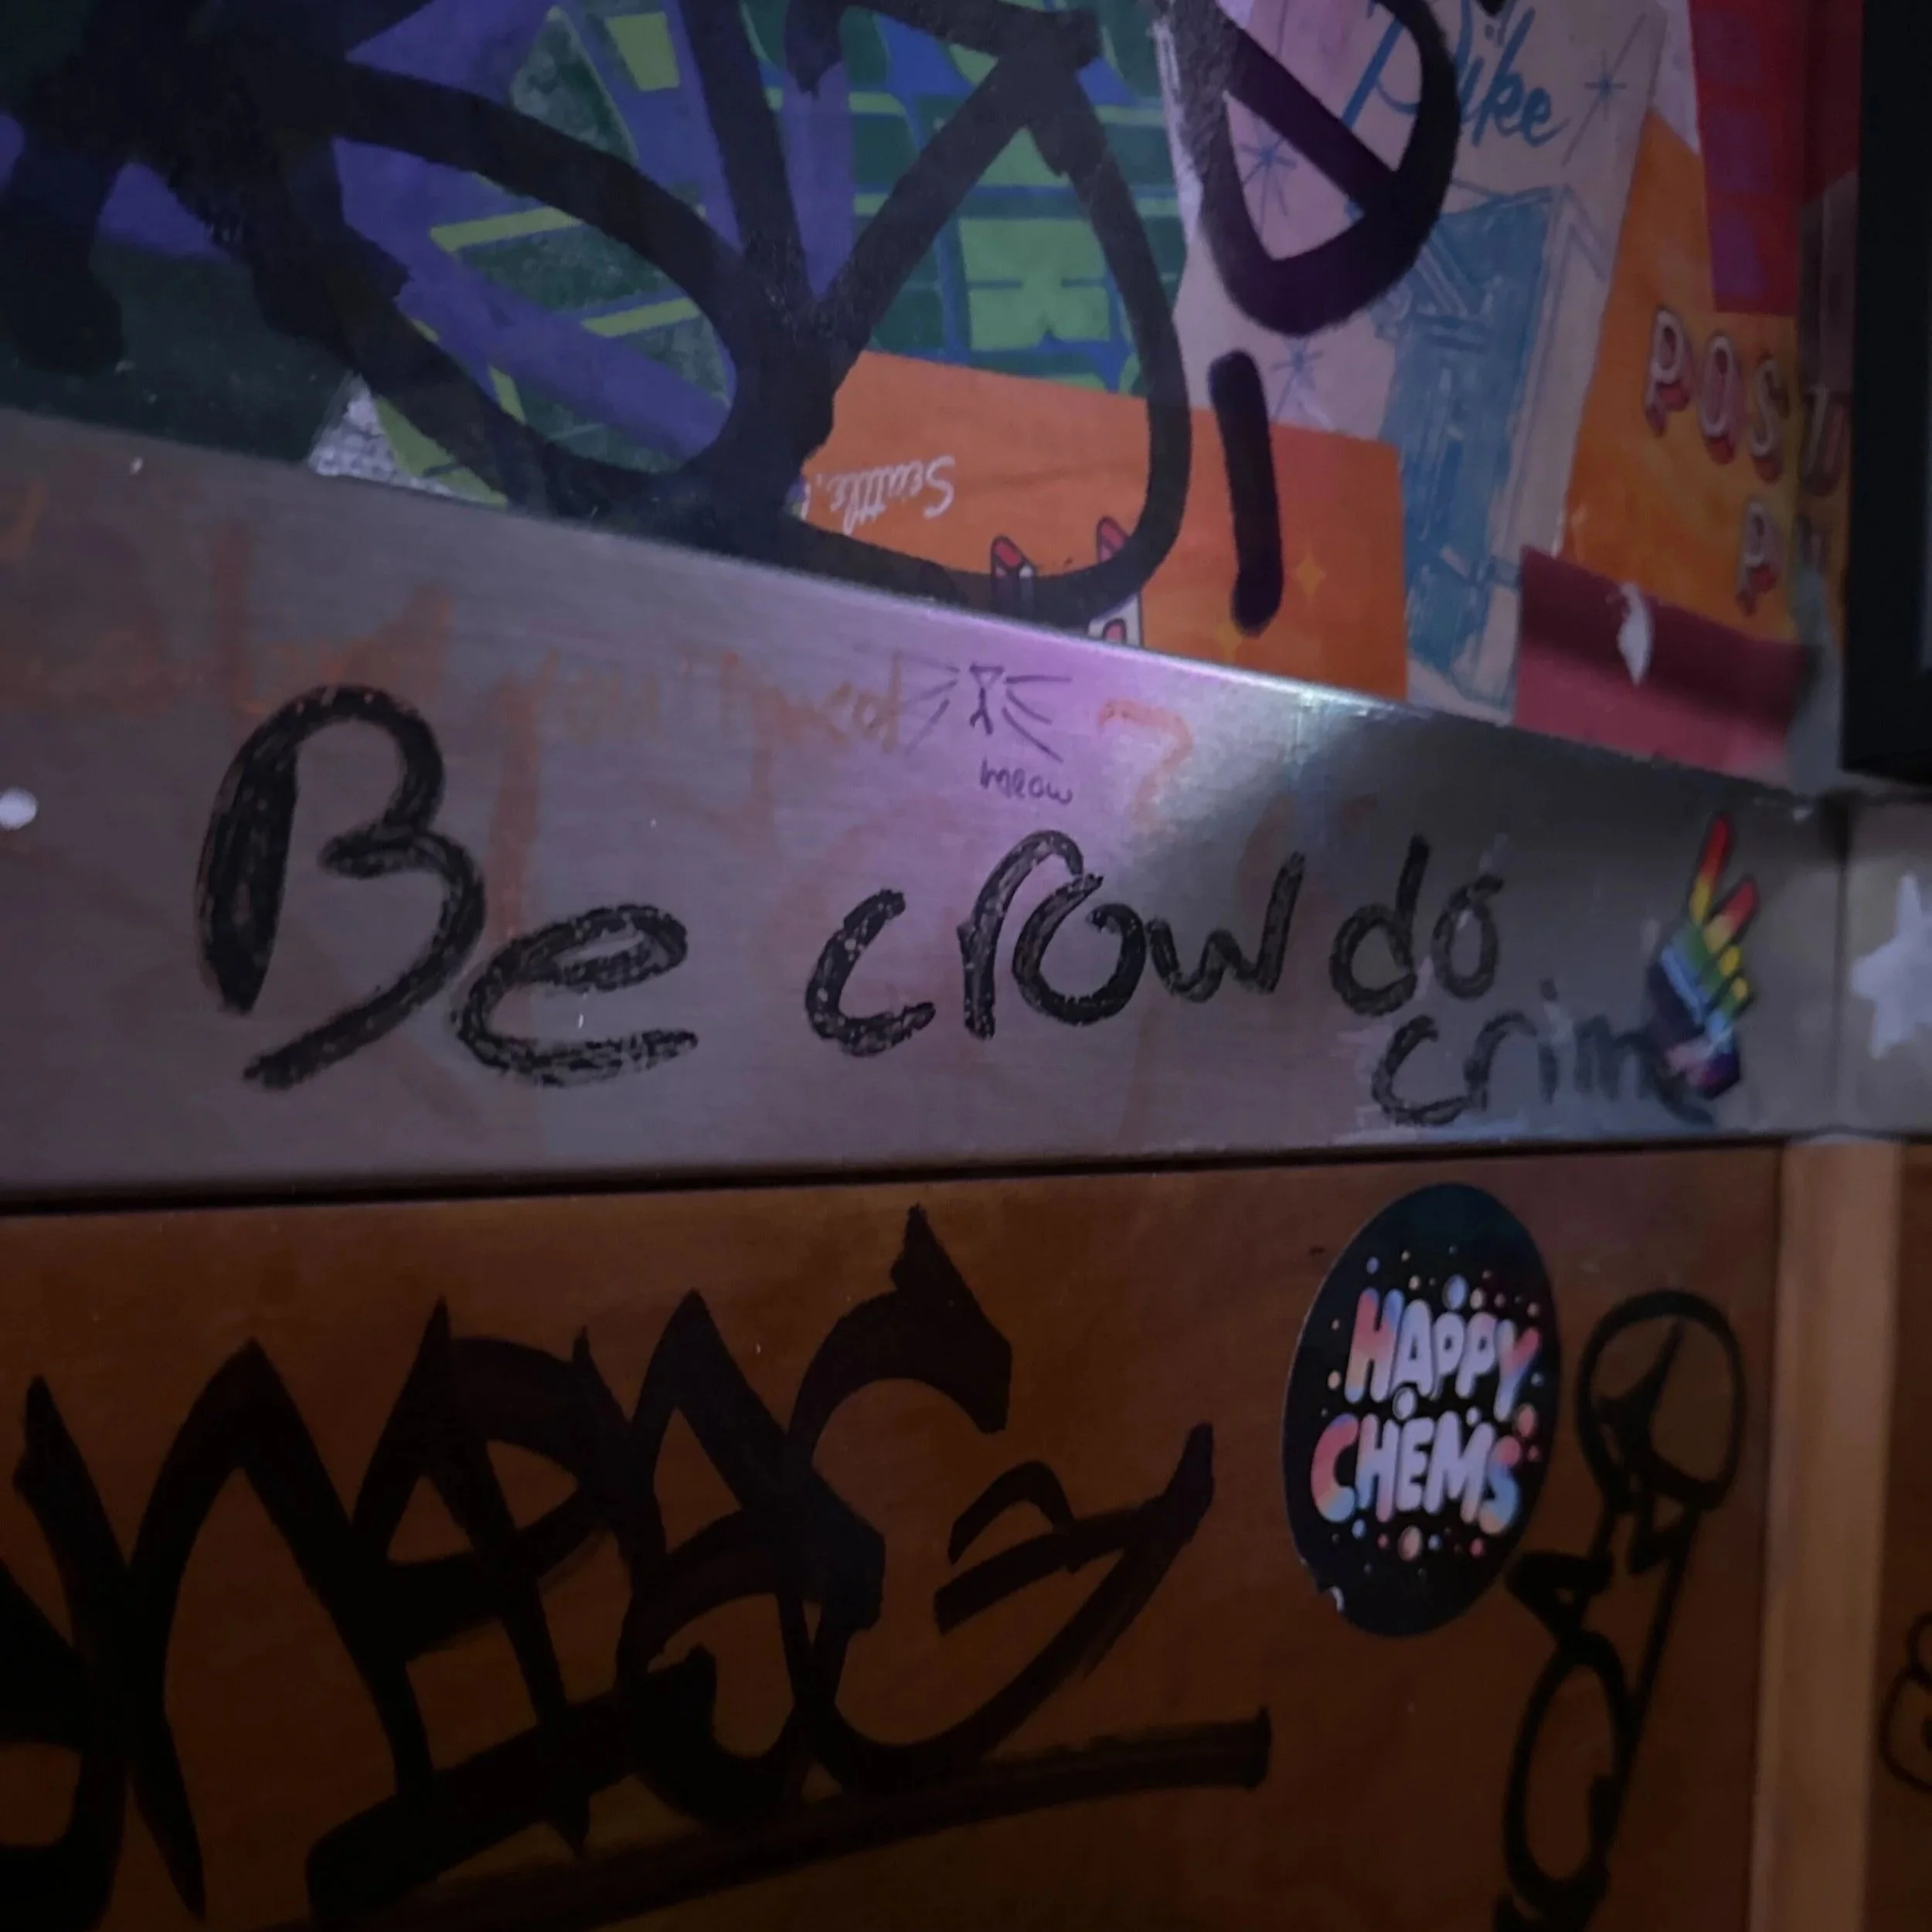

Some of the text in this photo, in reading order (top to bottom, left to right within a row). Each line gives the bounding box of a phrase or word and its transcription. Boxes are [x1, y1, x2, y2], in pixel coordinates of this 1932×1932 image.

[980, 757, 1074, 805] meow
[196, 685, 697, 1087] Be
[805, 830, 1304, 1056] crow
[1329, 834, 1504, 1017] do
[1343, 1286, 1543, 1423] HAPPY
[1309, 1410, 1522, 1536] CHEMS
